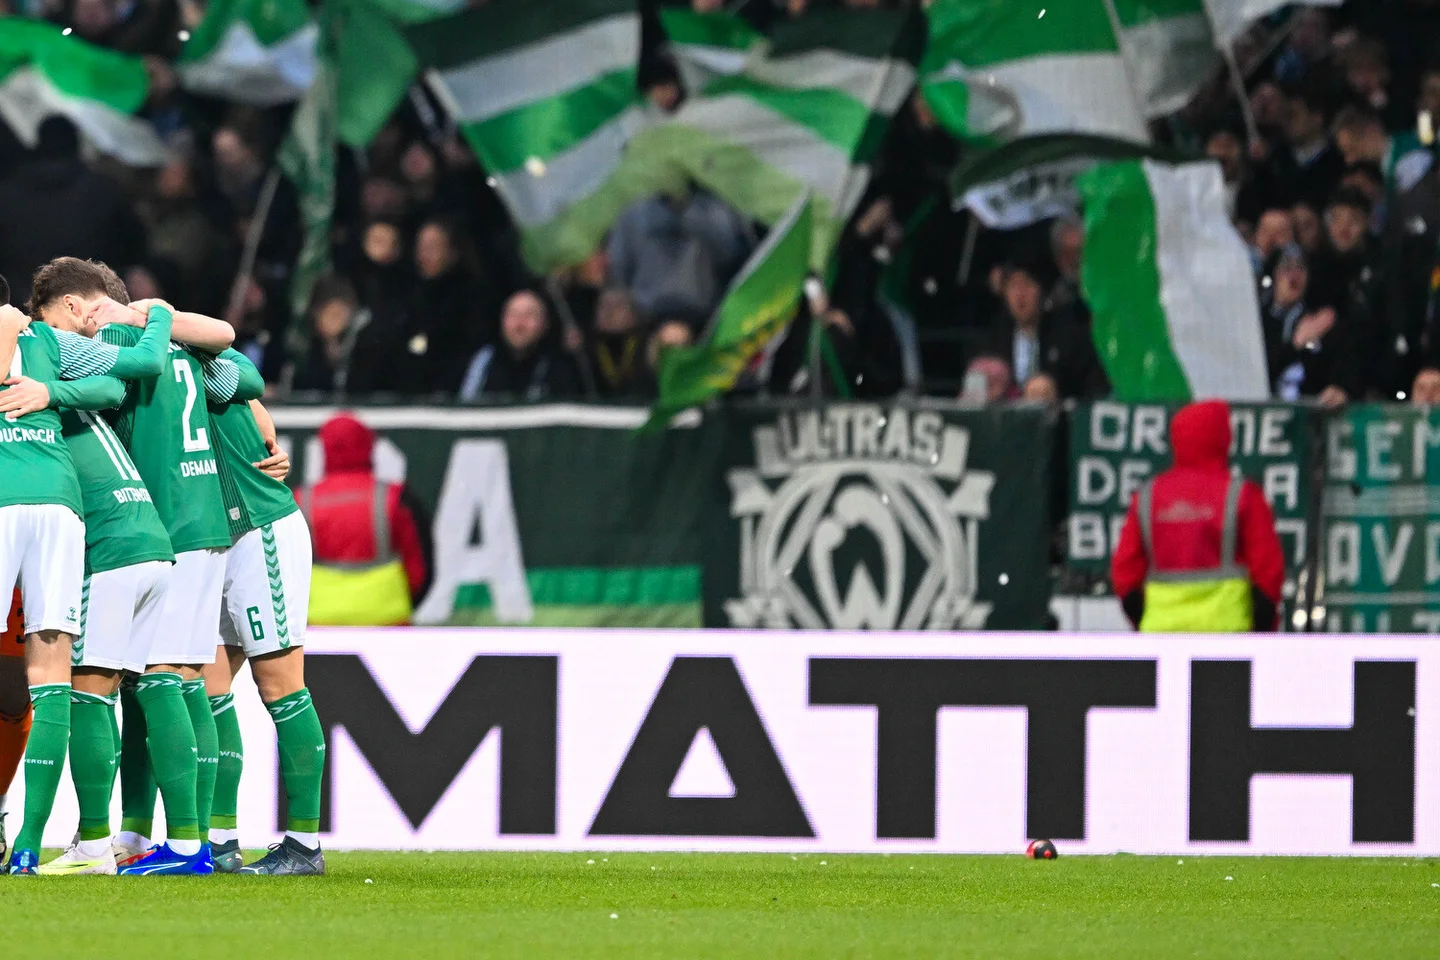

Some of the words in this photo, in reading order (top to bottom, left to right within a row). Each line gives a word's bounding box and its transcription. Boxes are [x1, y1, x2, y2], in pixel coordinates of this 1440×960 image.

[172, 359, 210, 453] 2
[778, 405, 946, 462] ULTRAS
[246, 605, 265, 641] 6
[277, 653, 1417, 844] MATTH
